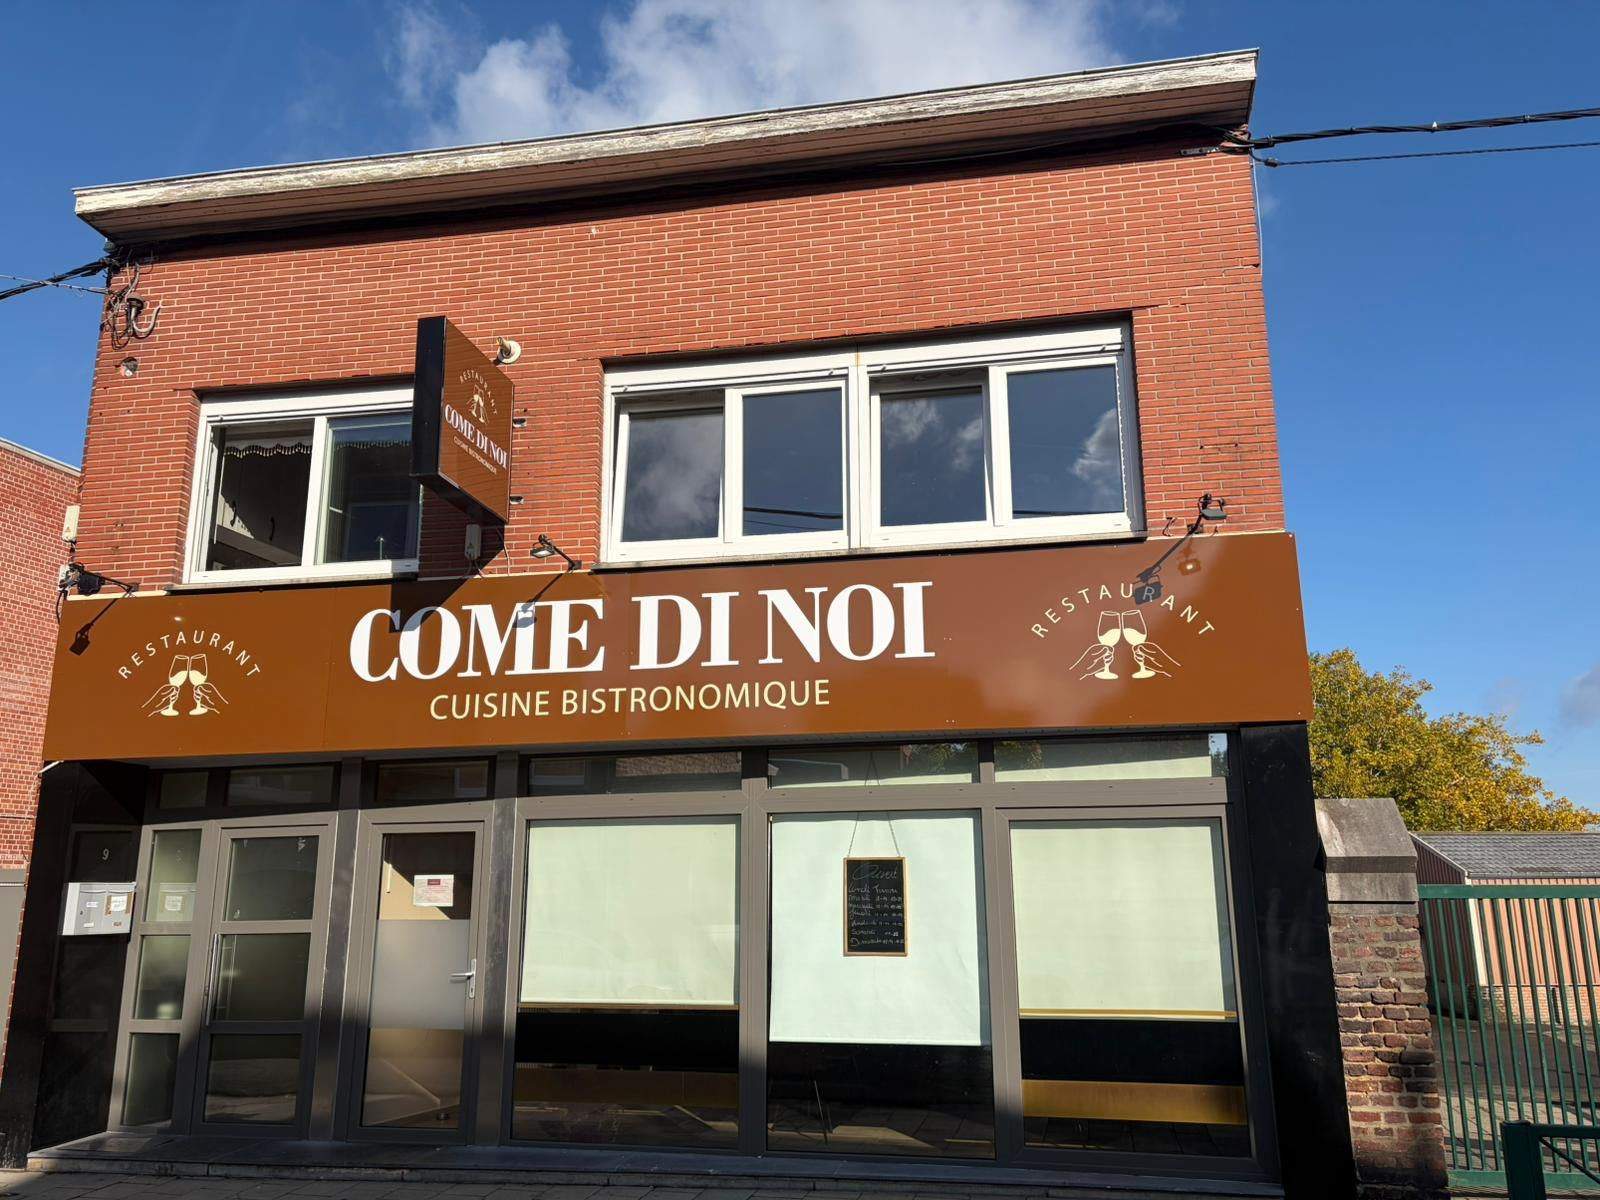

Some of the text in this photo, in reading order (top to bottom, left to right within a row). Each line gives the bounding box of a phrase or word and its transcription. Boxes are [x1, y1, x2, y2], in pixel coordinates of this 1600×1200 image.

[445, 403, 475, 443] COME
[476, 428, 488, 455] DI
[489, 439, 507, 469] NOI
[349, 581, 936, 683] COME DI NOI
[1031, 582, 1215, 638] RESTAURANT
[118, 629, 261, 679] RESTAURANT
[429, 679, 831, 721] CUISINE BISTRONOMIQUE
[102, 848, 110, 860] 9
